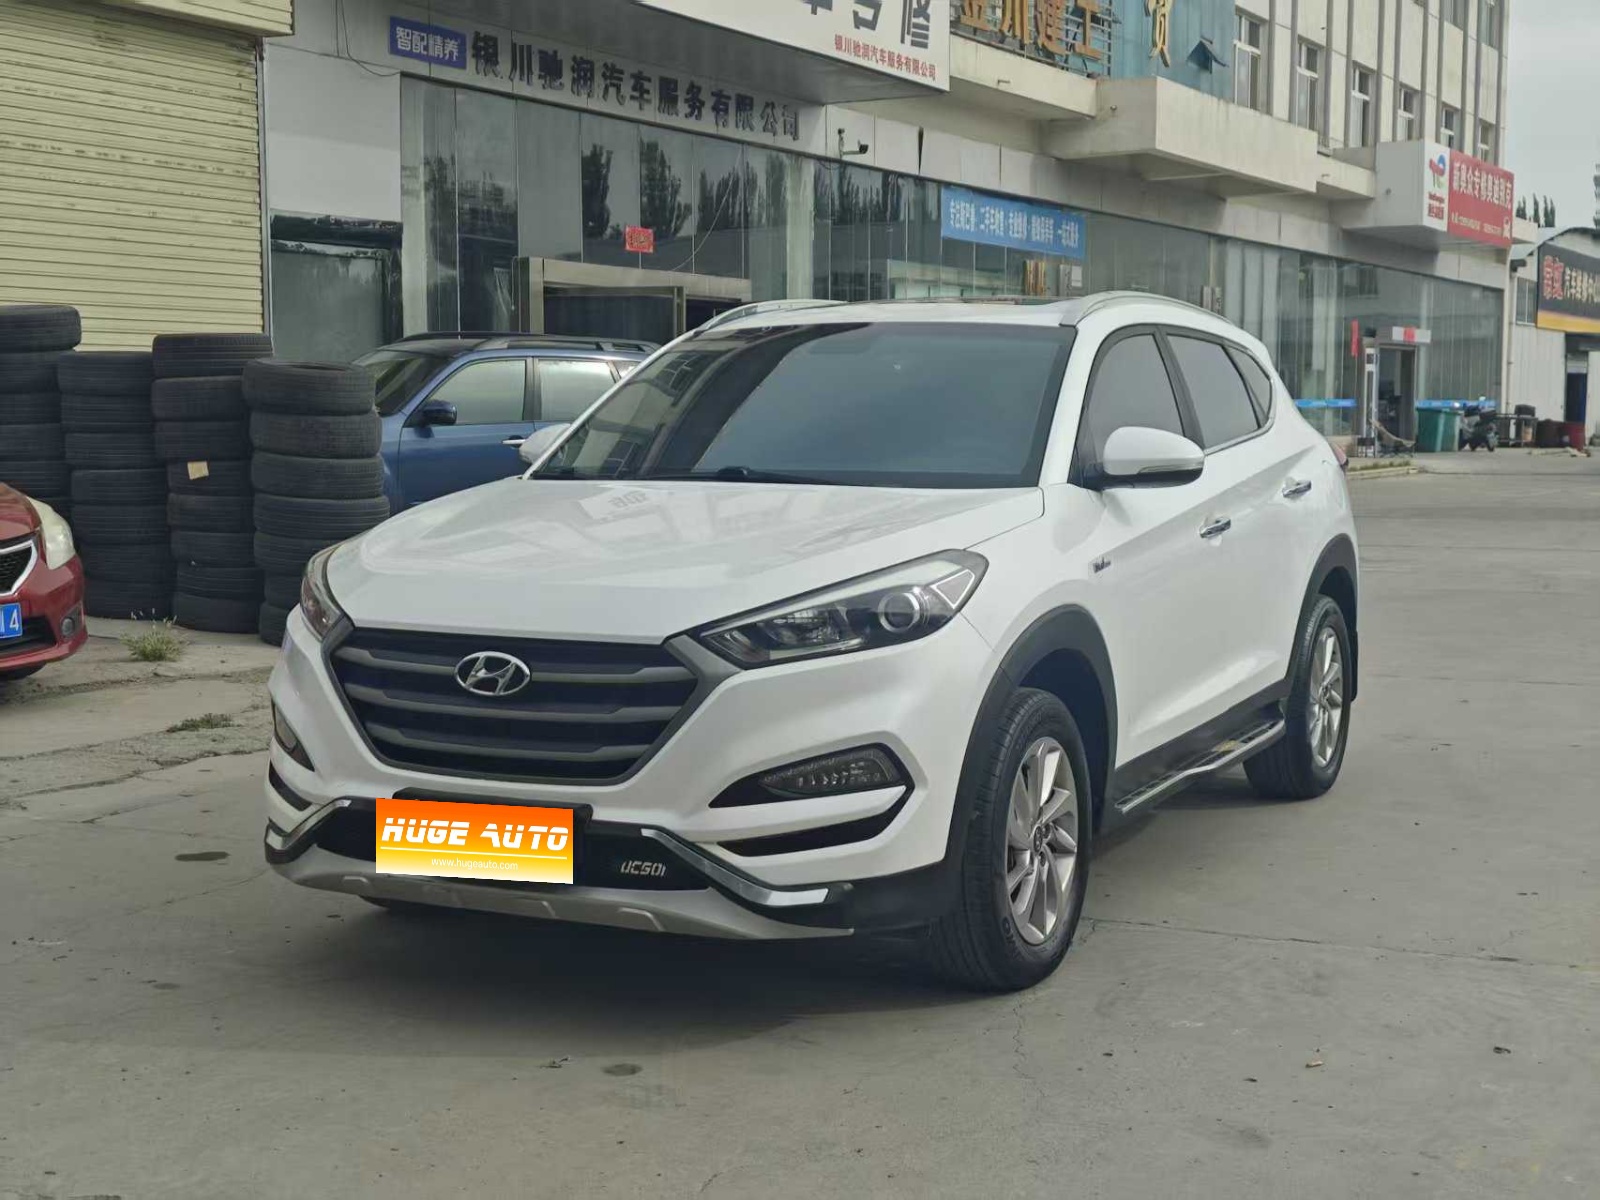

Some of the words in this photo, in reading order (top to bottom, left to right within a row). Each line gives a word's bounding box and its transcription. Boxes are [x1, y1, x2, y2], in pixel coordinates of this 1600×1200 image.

[396, 26, 459, 61] 智配精养
[834, 33, 937, 82] 银川驰润汽车服务有限公司
[471, 30, 799, 141] 银川驰润汽车服务有限公司
